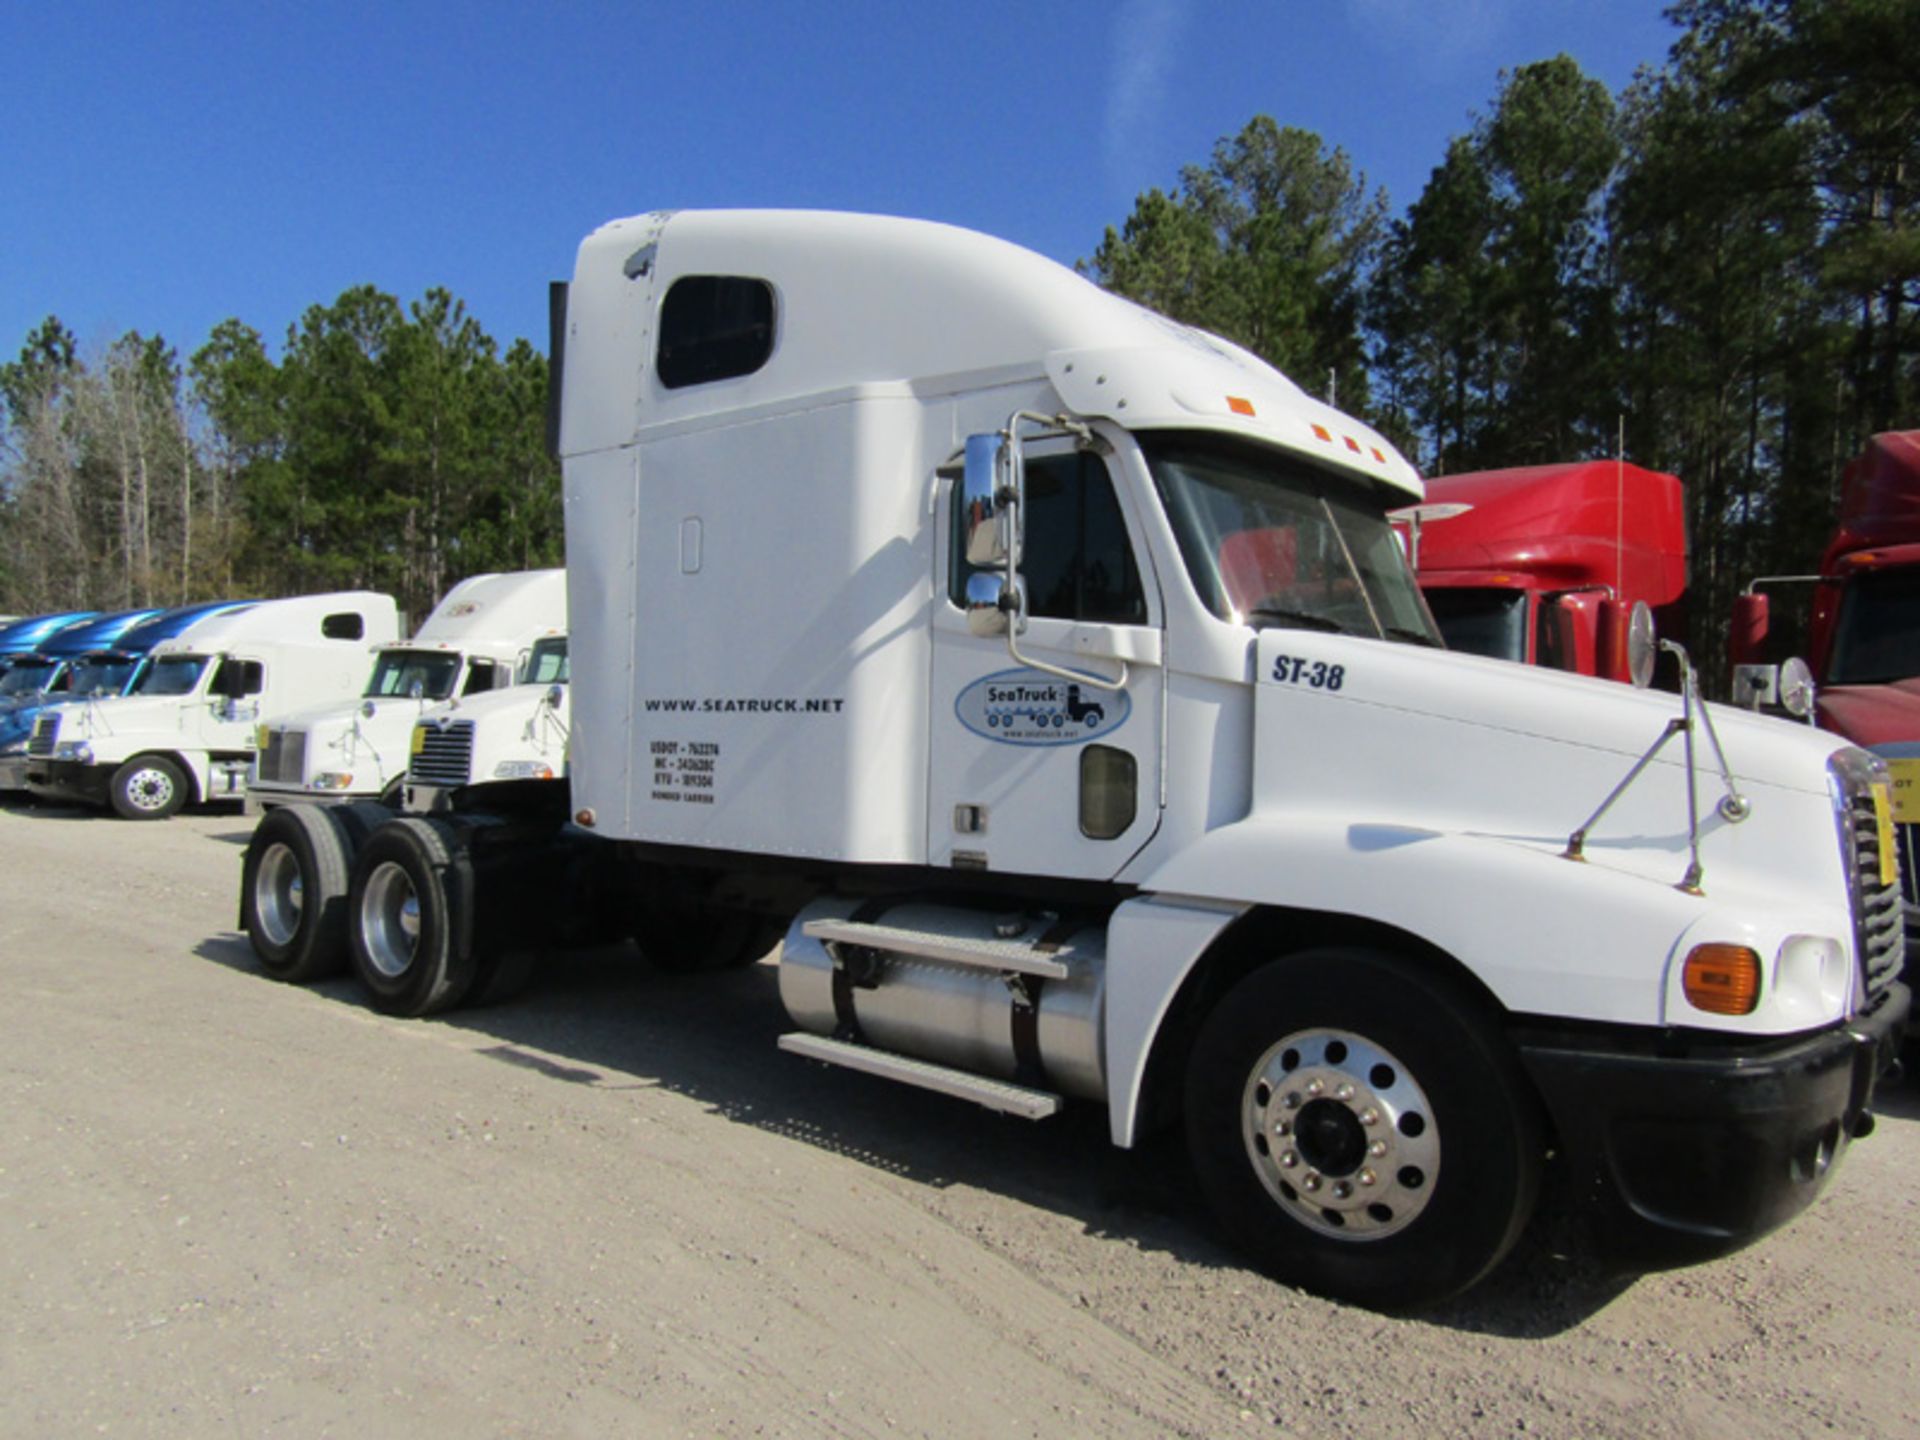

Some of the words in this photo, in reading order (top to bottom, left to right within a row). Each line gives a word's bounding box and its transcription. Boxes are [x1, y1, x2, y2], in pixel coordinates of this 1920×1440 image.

[1272, 654, 1345, 691] ST-38
[988, 686, 1057, 702] SeaTruck
[645, 698, 844, 713] WWW.SEATRUCK.NET
[650, 741, 678, 754] USDOT
